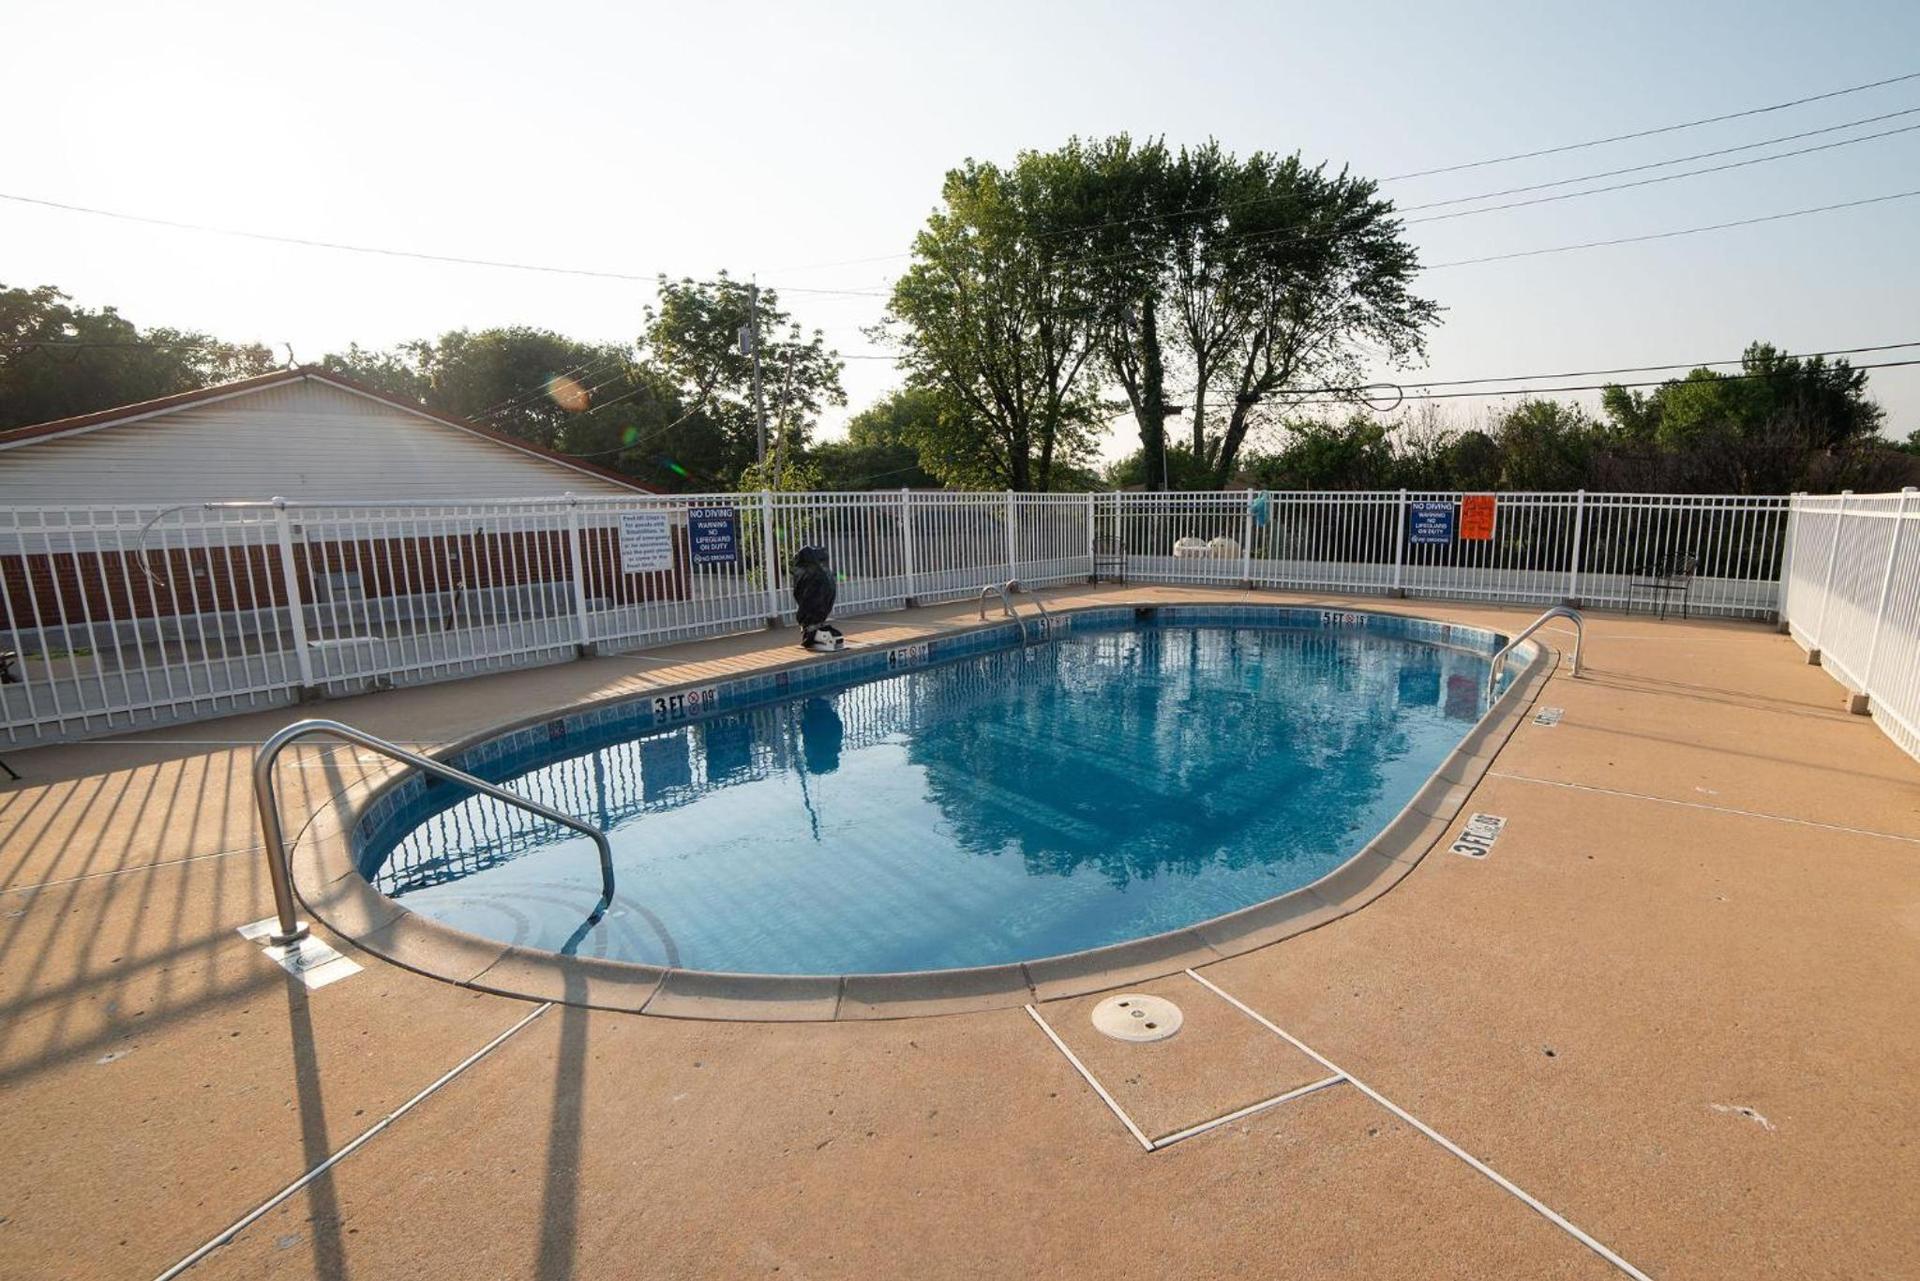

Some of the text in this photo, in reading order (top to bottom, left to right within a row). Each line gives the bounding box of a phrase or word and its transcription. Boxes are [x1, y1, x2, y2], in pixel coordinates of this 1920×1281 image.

[690, 509, 732, 518] NO DIVING
[698, 521, 728, 529] WARNING
[696, 535, 731, 544] LIFEGUARD
[655, 697, 667, 713] 3
[669, 694, 685, 711] FT
[1459, 831, 1494, 846] FT
[1454, 844, 1487, 857] 3
